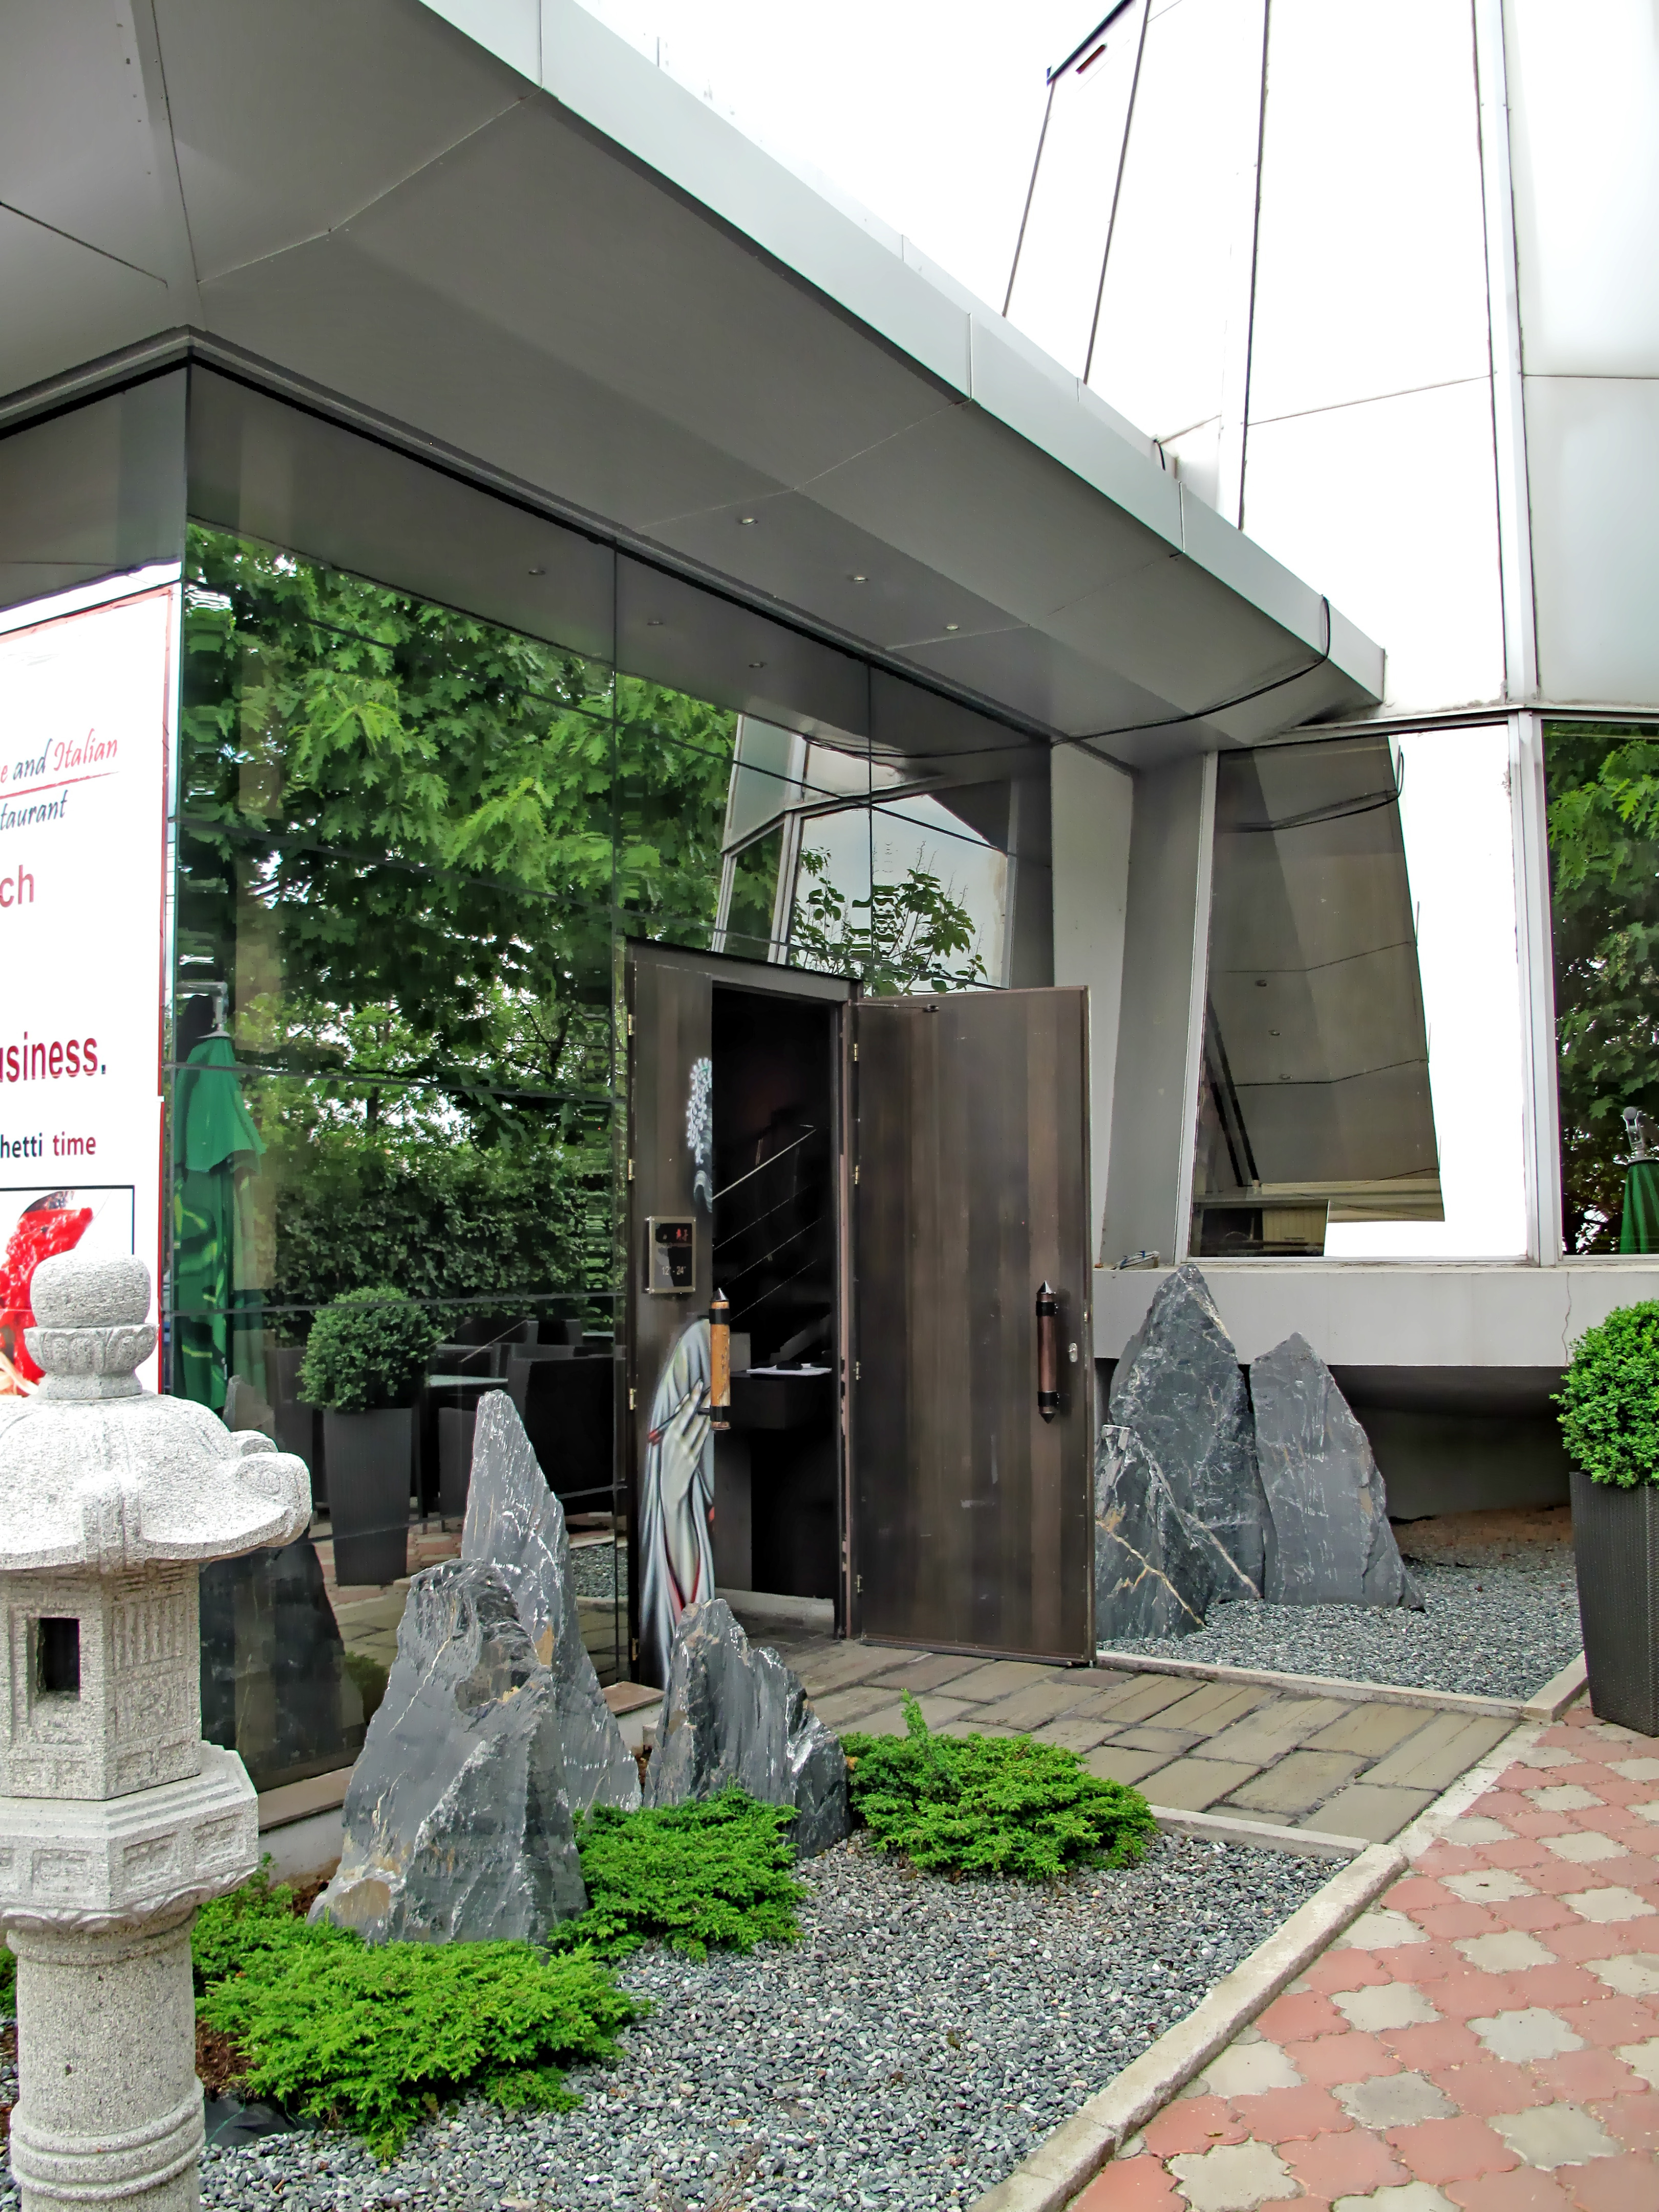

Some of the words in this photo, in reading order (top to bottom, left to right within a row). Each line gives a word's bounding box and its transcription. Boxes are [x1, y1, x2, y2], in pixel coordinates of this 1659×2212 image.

[13, 738, 53, 780] and
[53, 728, 118, 771] Italian
[0, 790, 68, 831] taurant
[0, 1132, 42, 1158] hetti
[53, 1131, 96, 1156] time
